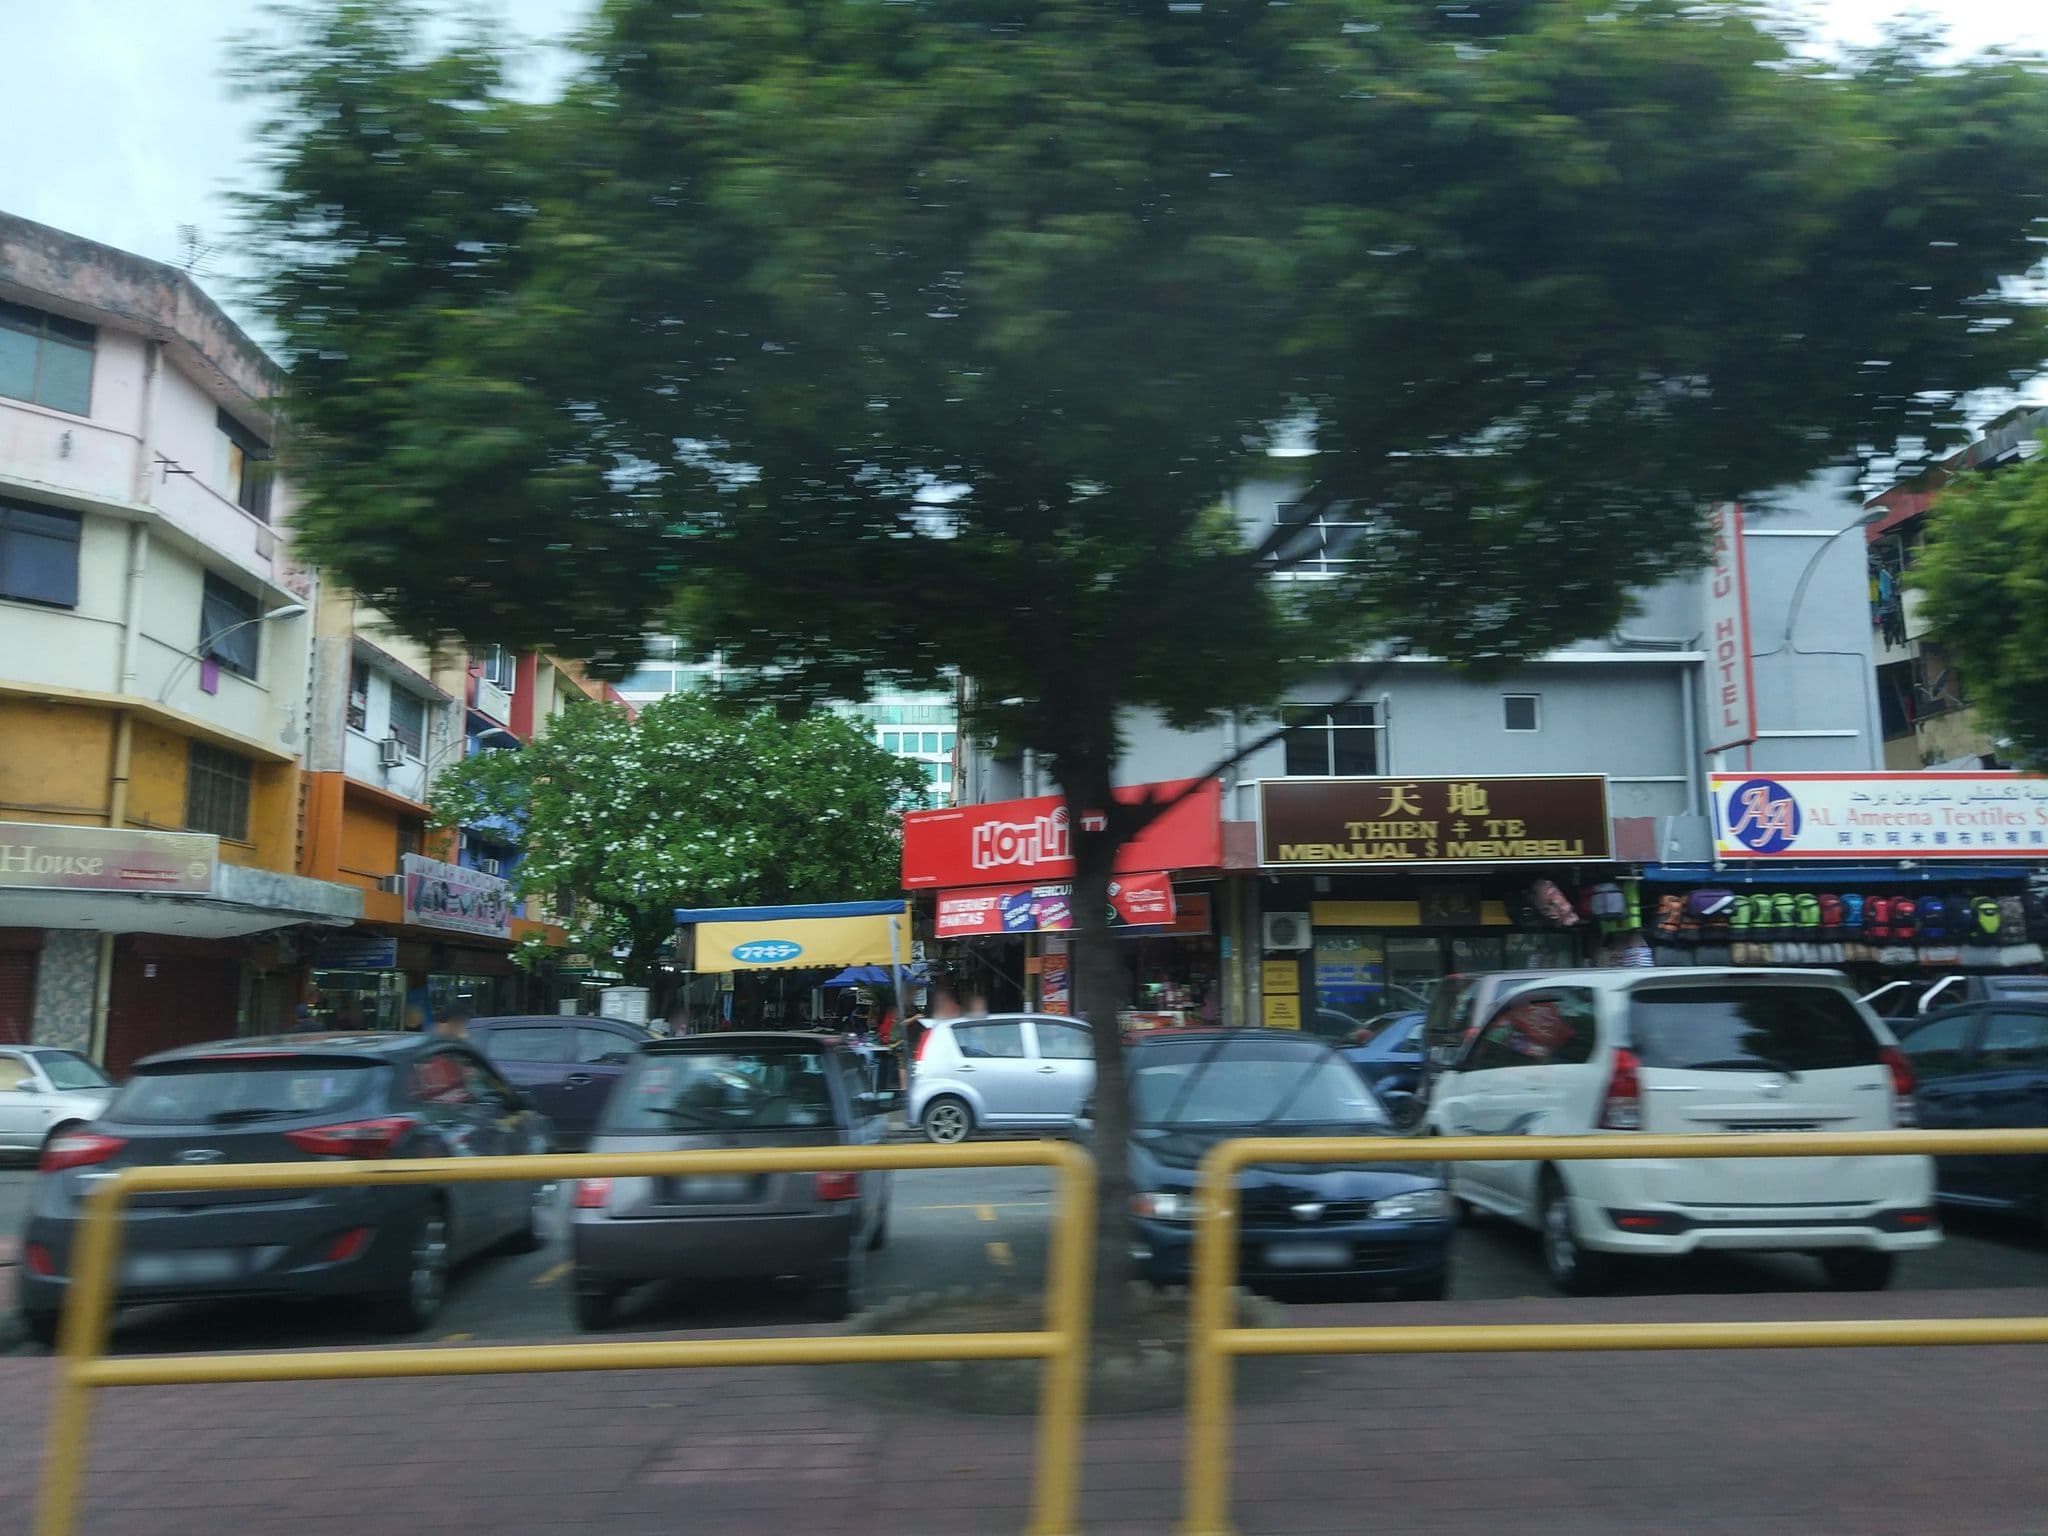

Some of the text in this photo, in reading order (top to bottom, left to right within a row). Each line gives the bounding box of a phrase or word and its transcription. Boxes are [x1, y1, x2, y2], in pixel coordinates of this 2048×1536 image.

[1715, 618, 1739, 728] HOTEL
[1808, 808, 1839, 825] AL
[1847, 807, 1933, 826] Ameena
[1940, 806, 2027, 826] Textiles
[1343, 819, 1527, 840] THIEN TE
[0, 844, 104, 876] House
[1278, 842, 1417, 861] MENJUAL
[1446, 839, 1584, 858] MEMBELI
[939, 897, 998, 914] INTERNET
